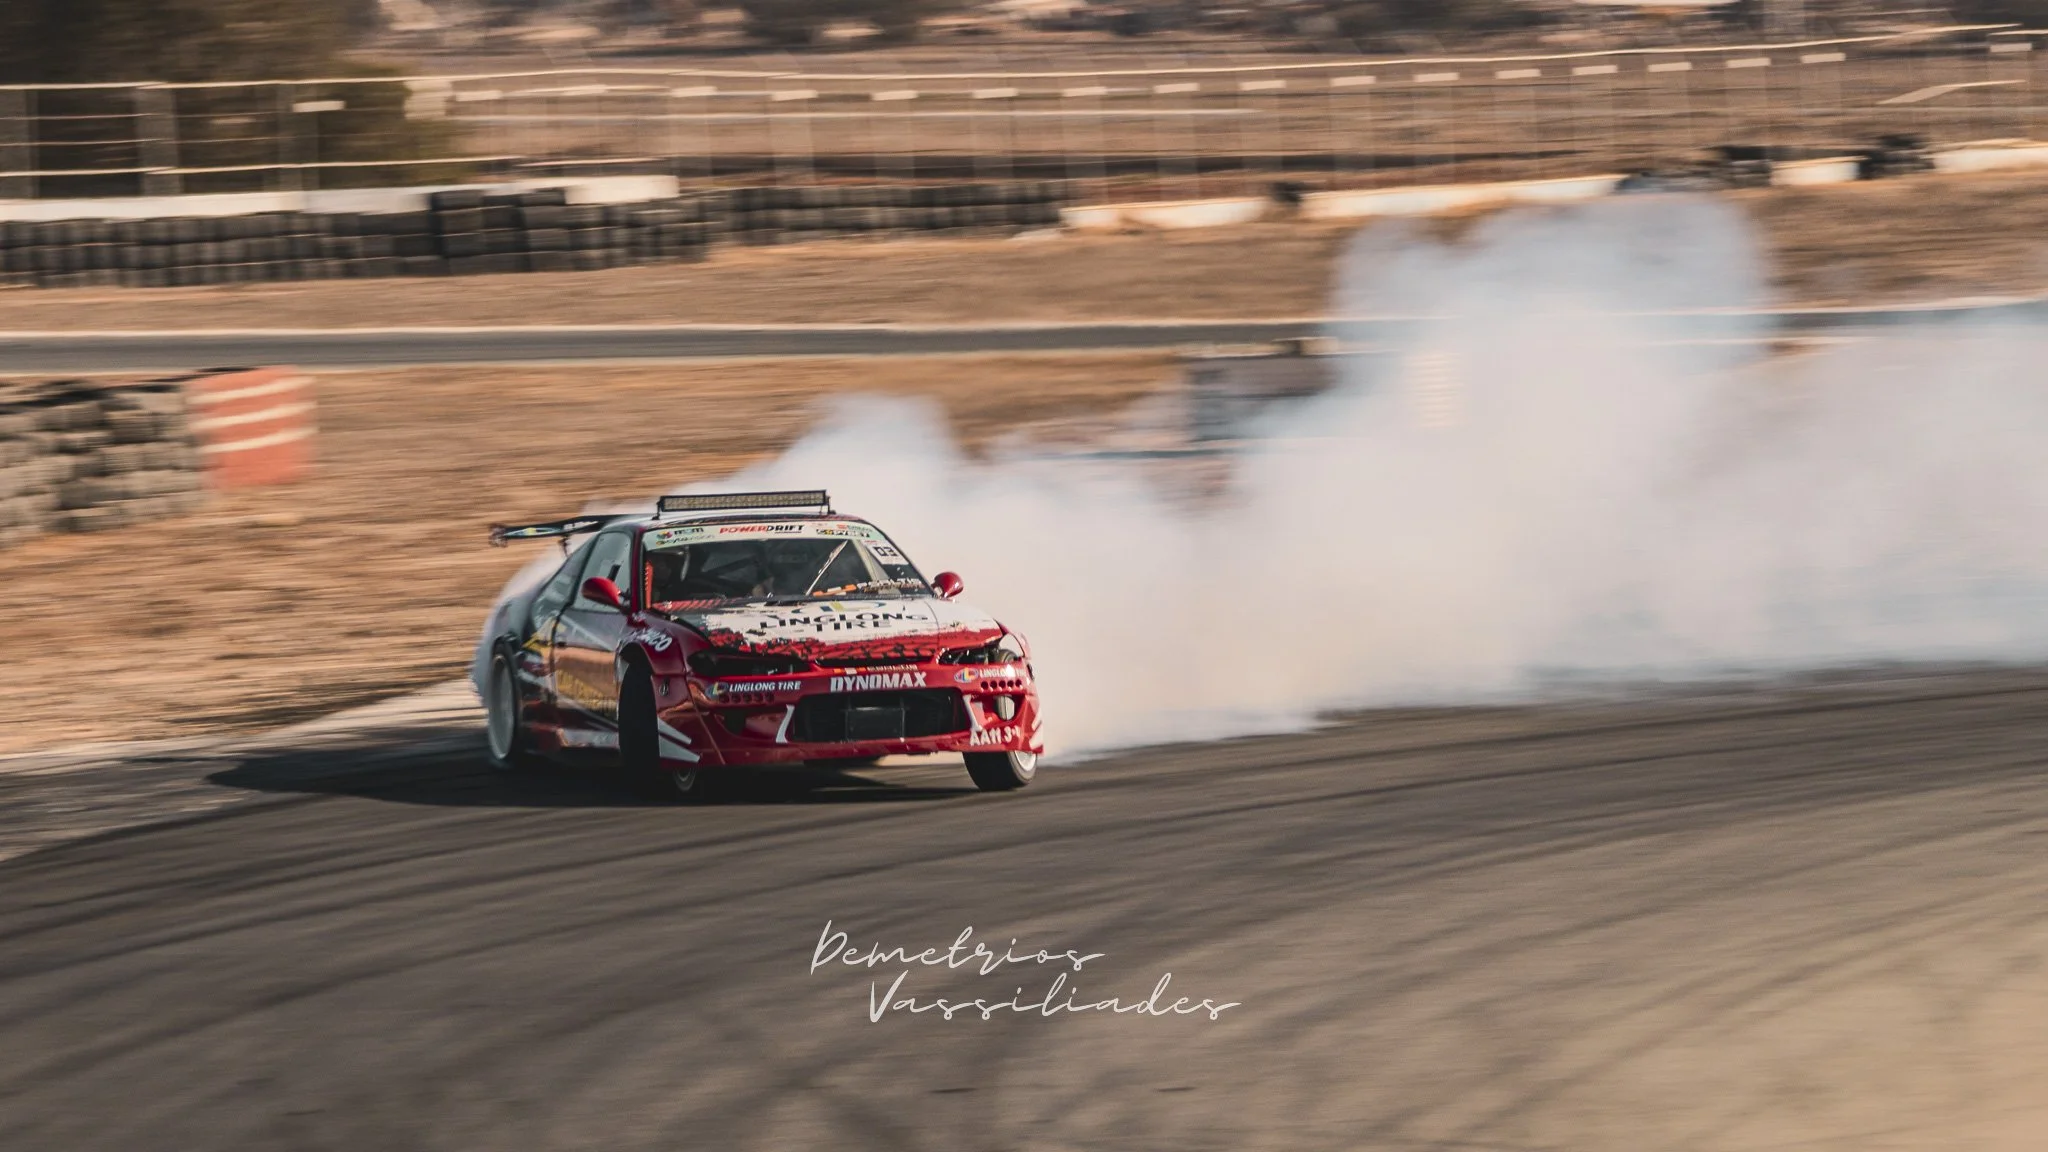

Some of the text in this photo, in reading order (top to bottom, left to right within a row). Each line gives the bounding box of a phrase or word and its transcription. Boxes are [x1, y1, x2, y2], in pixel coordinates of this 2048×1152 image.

[719, 524, 805, 534] POWERDRIFT
[760, 612, 928, 629] LINGLONG
[815, 619, 892, 632] TIRE
[728, 680, 802, 693] LINGLONG TIRE
[830, 671, 927, 692] DYNOMAX
